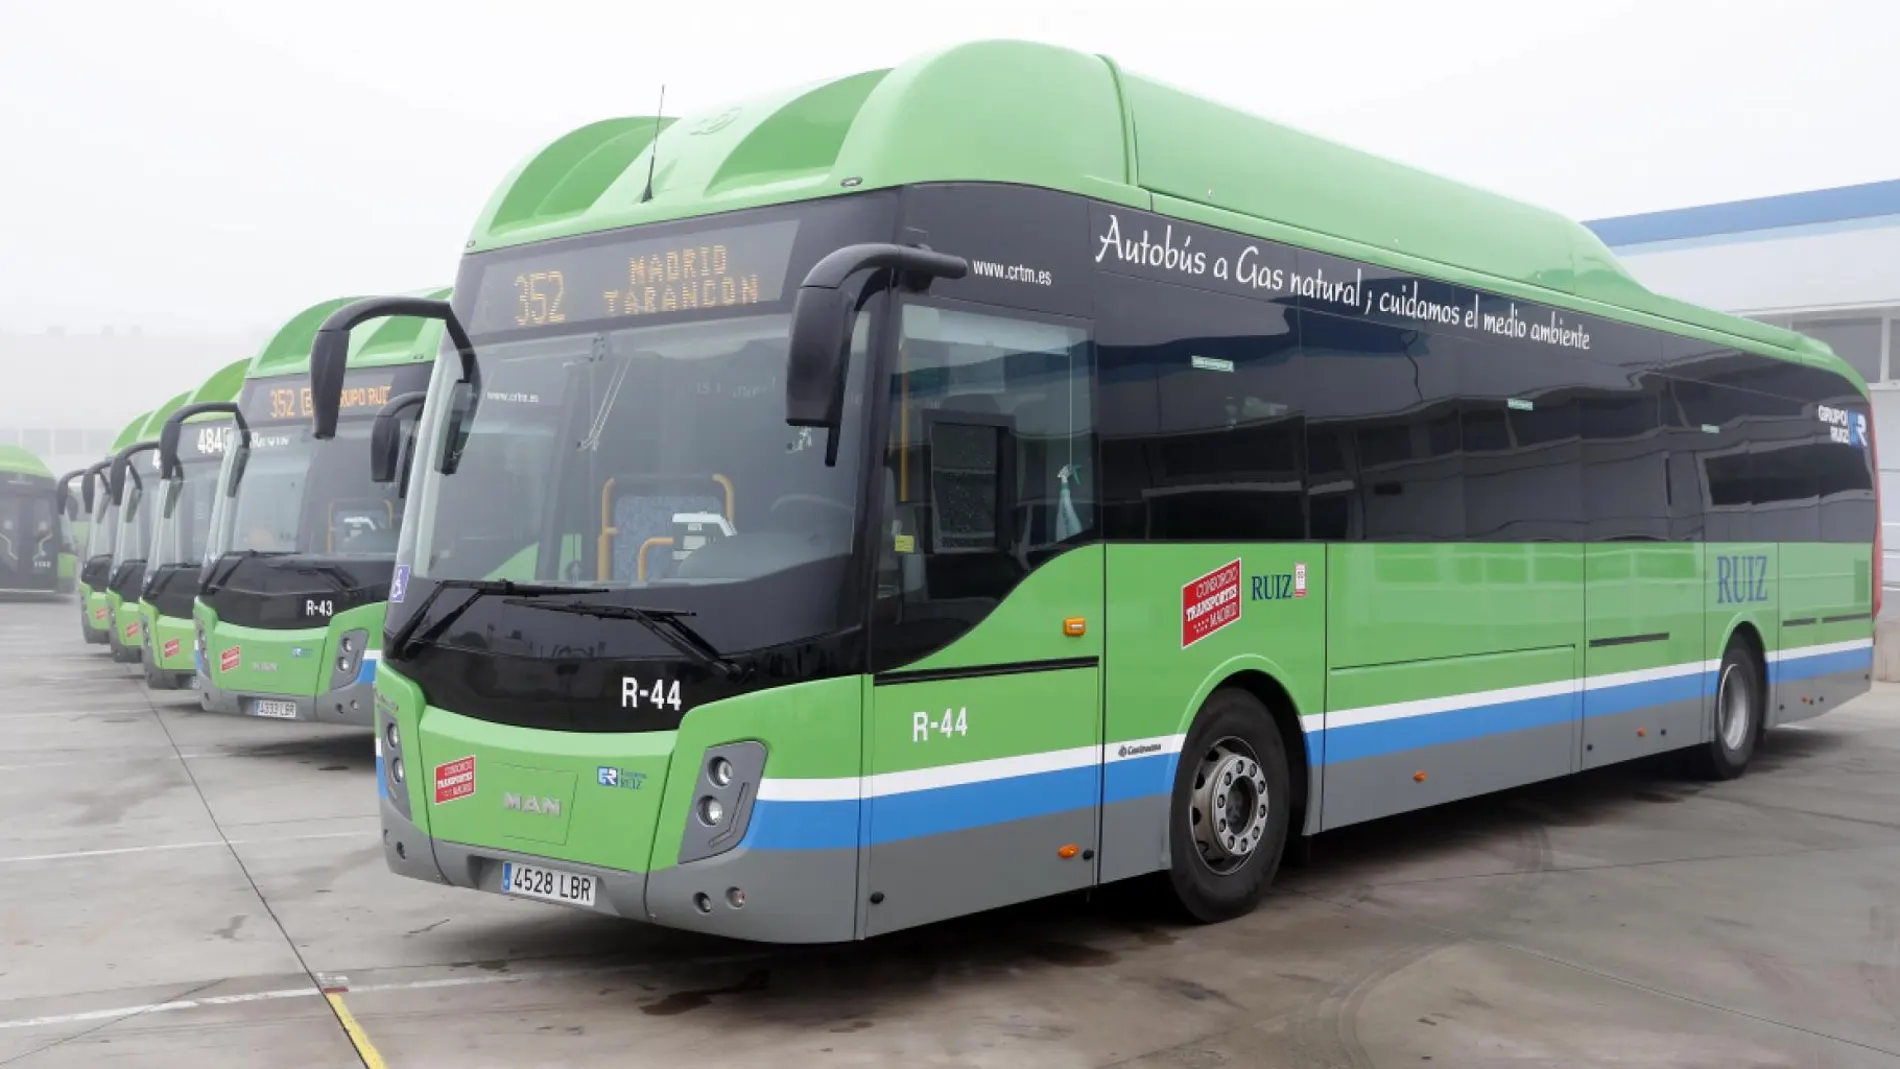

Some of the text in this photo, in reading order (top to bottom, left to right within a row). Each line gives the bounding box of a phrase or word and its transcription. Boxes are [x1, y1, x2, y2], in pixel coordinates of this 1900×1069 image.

[629, 245, 727, 285] MADRID
[972, 258, 1052, 286] www.crtm.es
[1095, 214, 1206, 275] Autobús
[1213, 257, 1228, 280] a
[1236, 246, 1283, 291] Gas
[1290, 268, 1362, 307] natural
[1379, 282, 1460, 326] cuidamos
[1465, 294, 1479, 330] el
[1484, 303, 1527, 339] medio
[1530, 311, 1591, 350] ambiente
[514, 271, 566, 326] 352
[270, 387, 296, 419] 352
[340, 387, 366, 408] RUPO
[1251, 574, 1293, 601] RUIZ
[1716, 556, 1769, 603] RUIZ
[306, 600, 333, 616] R-43
[1185, 584, 1238, 622] TRANSPORTES
[1209, 602, 1238, 628] MADRID
[622, 677, 682, 711] R-44
[912, 707, 969, 742] R-44
[503, 792, 561, 815] MAN
[514, 867, 591, 901] 4528 LBR
